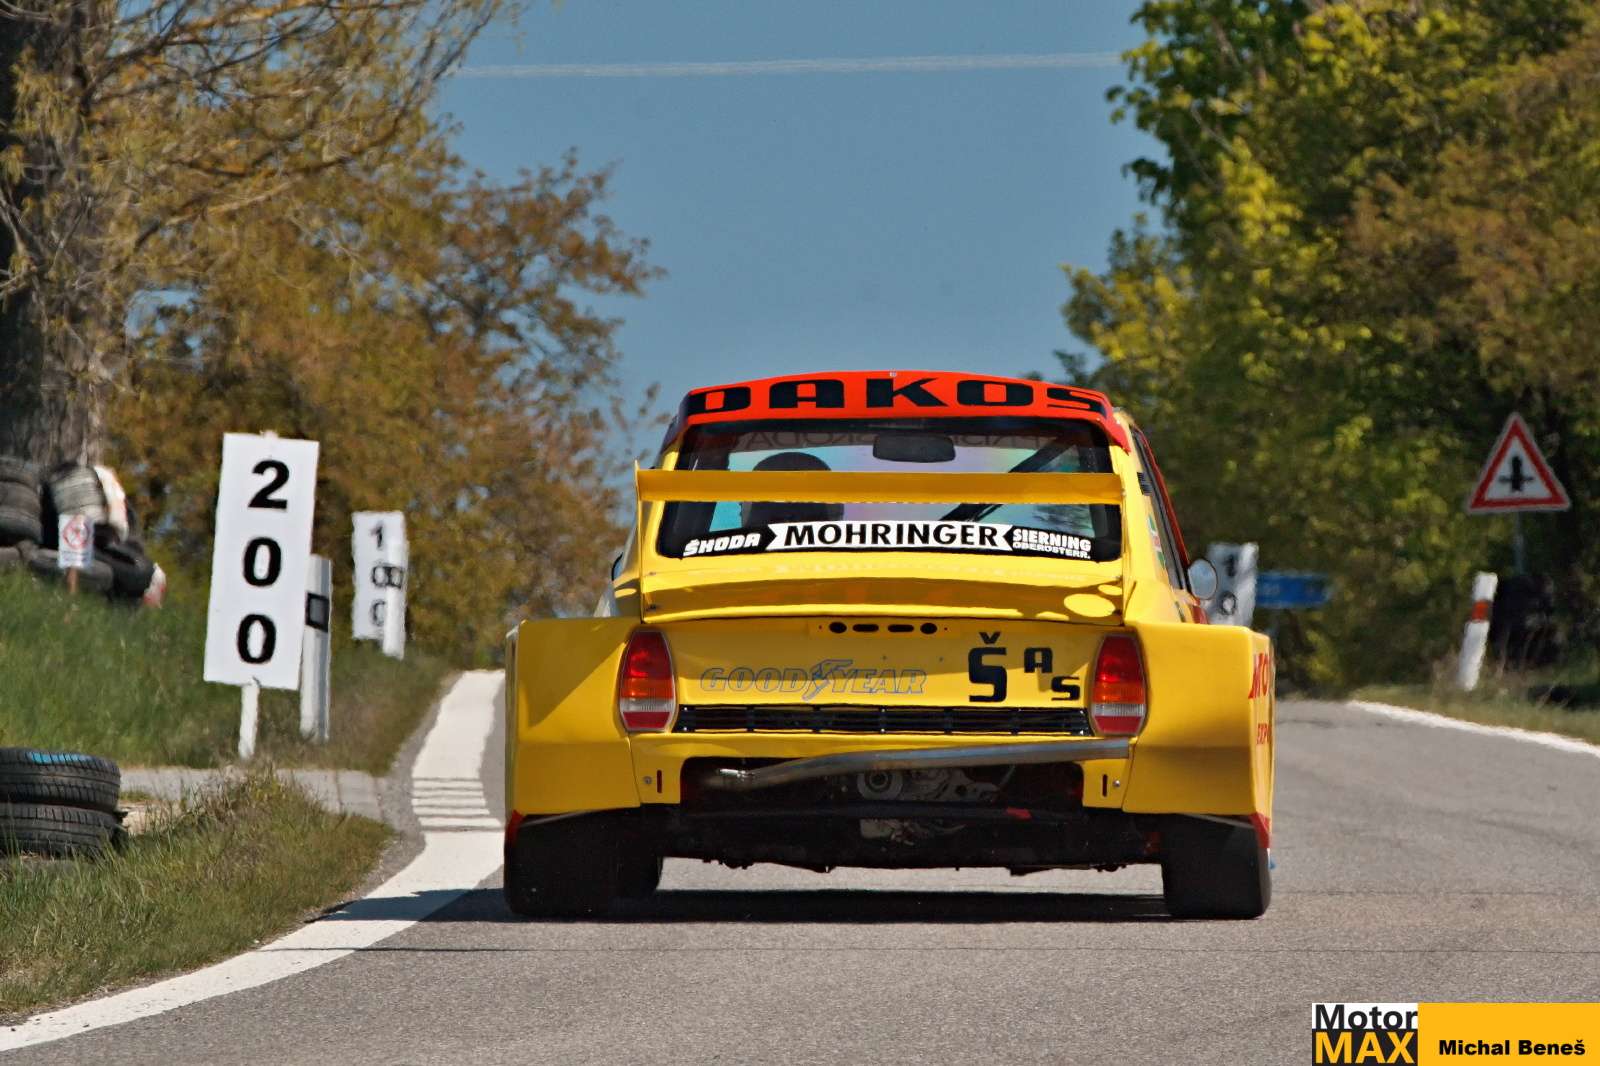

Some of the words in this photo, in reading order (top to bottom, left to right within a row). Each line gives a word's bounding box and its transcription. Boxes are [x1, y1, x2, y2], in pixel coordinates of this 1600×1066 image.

[687, 377, 1107, 419] DAKOS
[784, 523, 999, 547] MOHRINGER
[1012, 528, 1092, 552] SIERNING
[237, 459, 290, 664] 200
